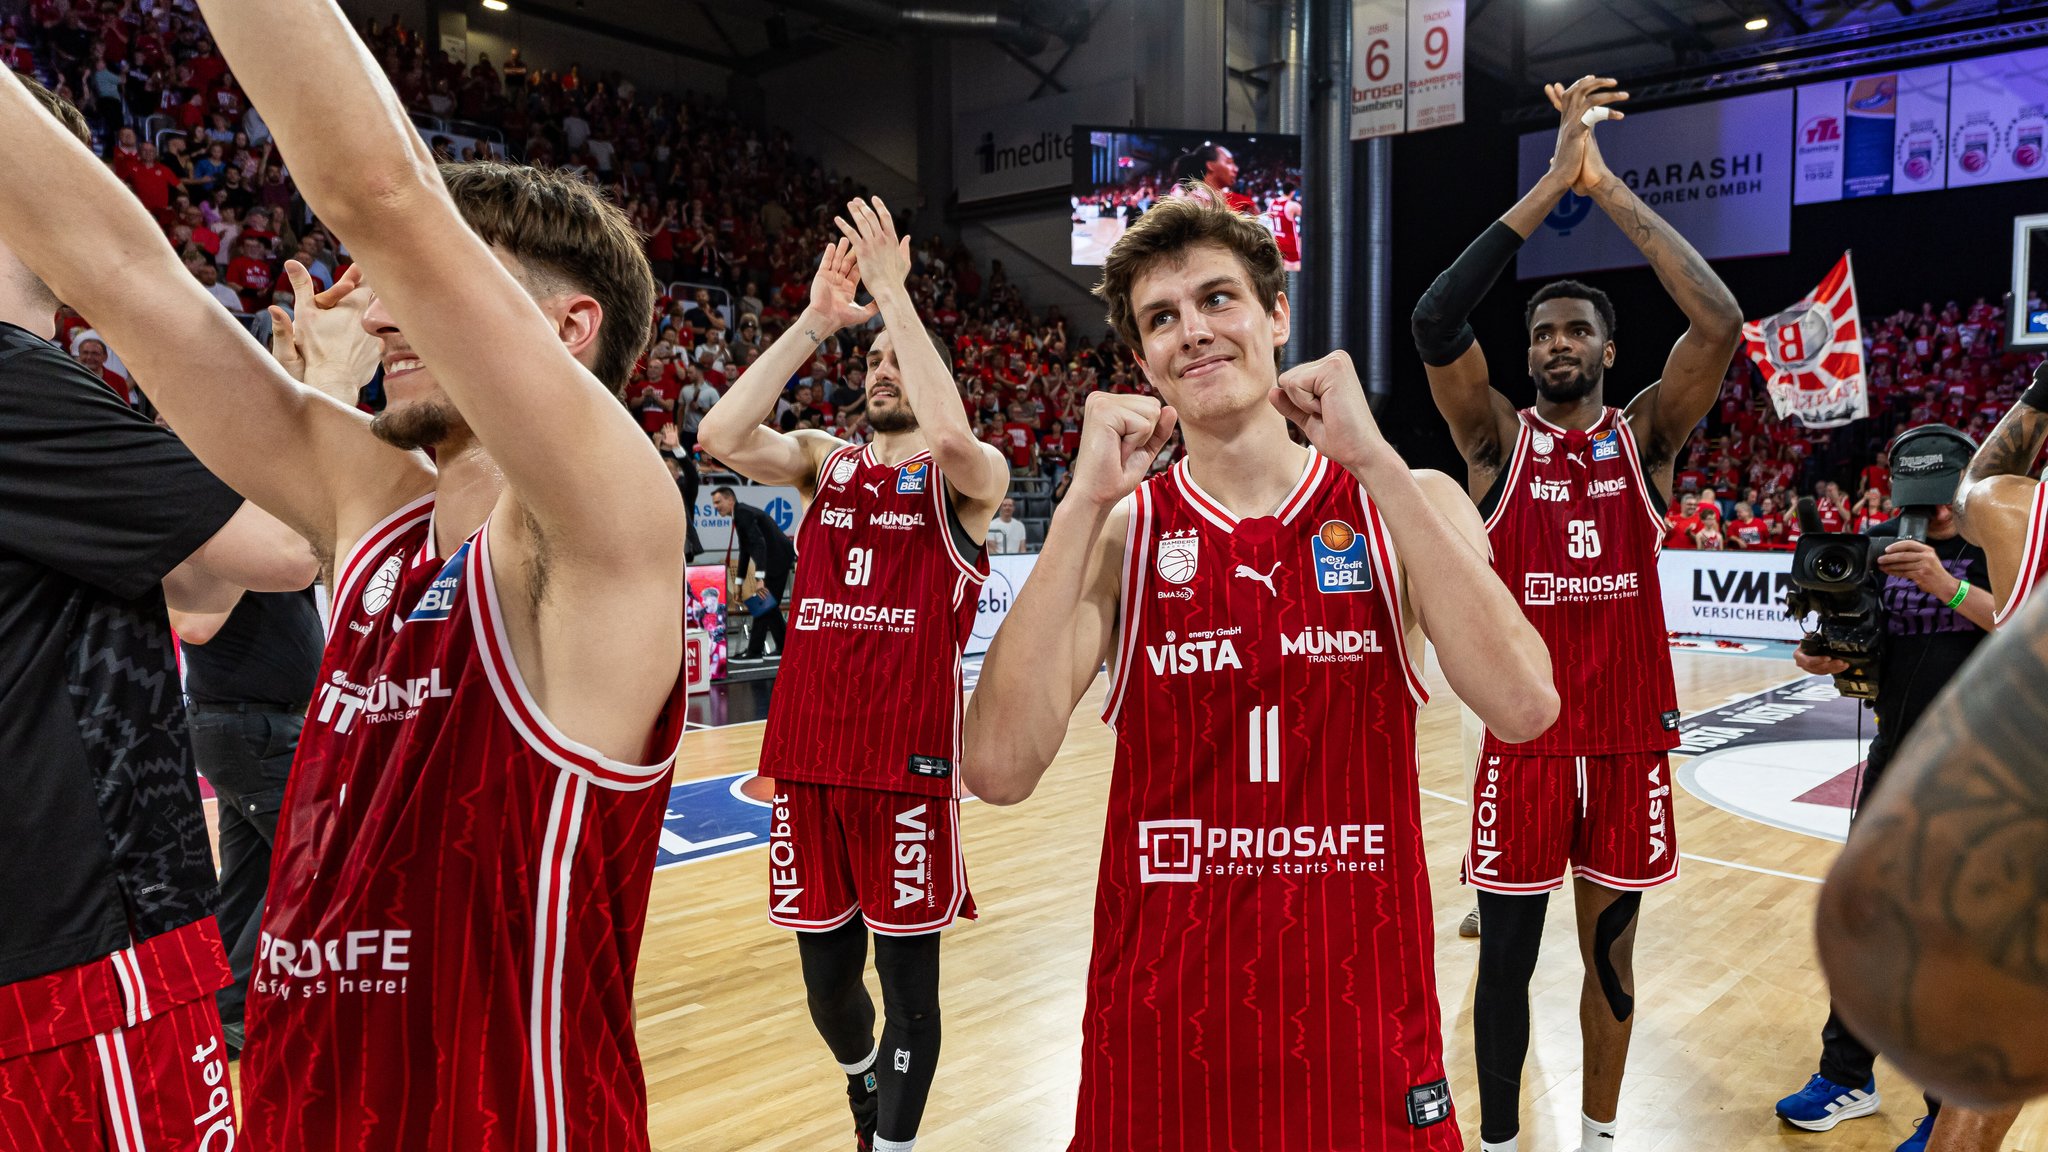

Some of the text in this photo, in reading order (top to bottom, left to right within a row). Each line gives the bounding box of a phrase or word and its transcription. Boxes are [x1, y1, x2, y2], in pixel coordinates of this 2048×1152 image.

[1425, 26, 1449, 71] 9
[1366, 39, 1390, 82] 6
[1352, 83, 1403, 103] brose
[1351, 98, 1403, 115] bamberg
[1623, 152, 1763, 190] GARASHI
[1638, 180, 1761, 206] TOREN GMBH
[1595, 446, 1618, 458] BBL
[899, 481, 922, 491] BBL
[1529, 475, 1570, 502] VISTA
[869, 511, 926, 526] MÜNDEL
[1567, 519, 1602, 559] 35
[844, 547, 873, 586] 31
[1333, 560, 1364, 570] Credit
[432, 577, 458, 588] edit
[1323, 569, 1366, 587] BBL
[1556, 572, 1639, 594] PRIOSAFE
[1692, 569, 1770, 605] LVM
[977, 588, 1007, 614] ebi
[1157, 590, 1190, 599] BMA365
[1556, 593, 1590, 603] safety
[823, 602, 916, 625] PRIOSAFE
[821, 620, 914, 634] safety starts here!
[1188, 626, 1242, 640] energy GmbH
[1280, 626, 1383, 656] MÜNDEL
[1146, 630, 1244, 676] VISTA
[1307, 653, 1364, 664] TRANS GMBH
[366, 710, 404, 725] TRANS
[1249, 705, 1280, 783] 11
[1648, 763, 1668, 865] VISTA
[1207, 824, 1386, 858] PRIOSAFE
[893, 803, 927, 909] VISTA
[1205, 858, 1385, 877] safety starts here!
[927, 881, 936, 908] GmbH
[339, 977, 408, 994] here!
